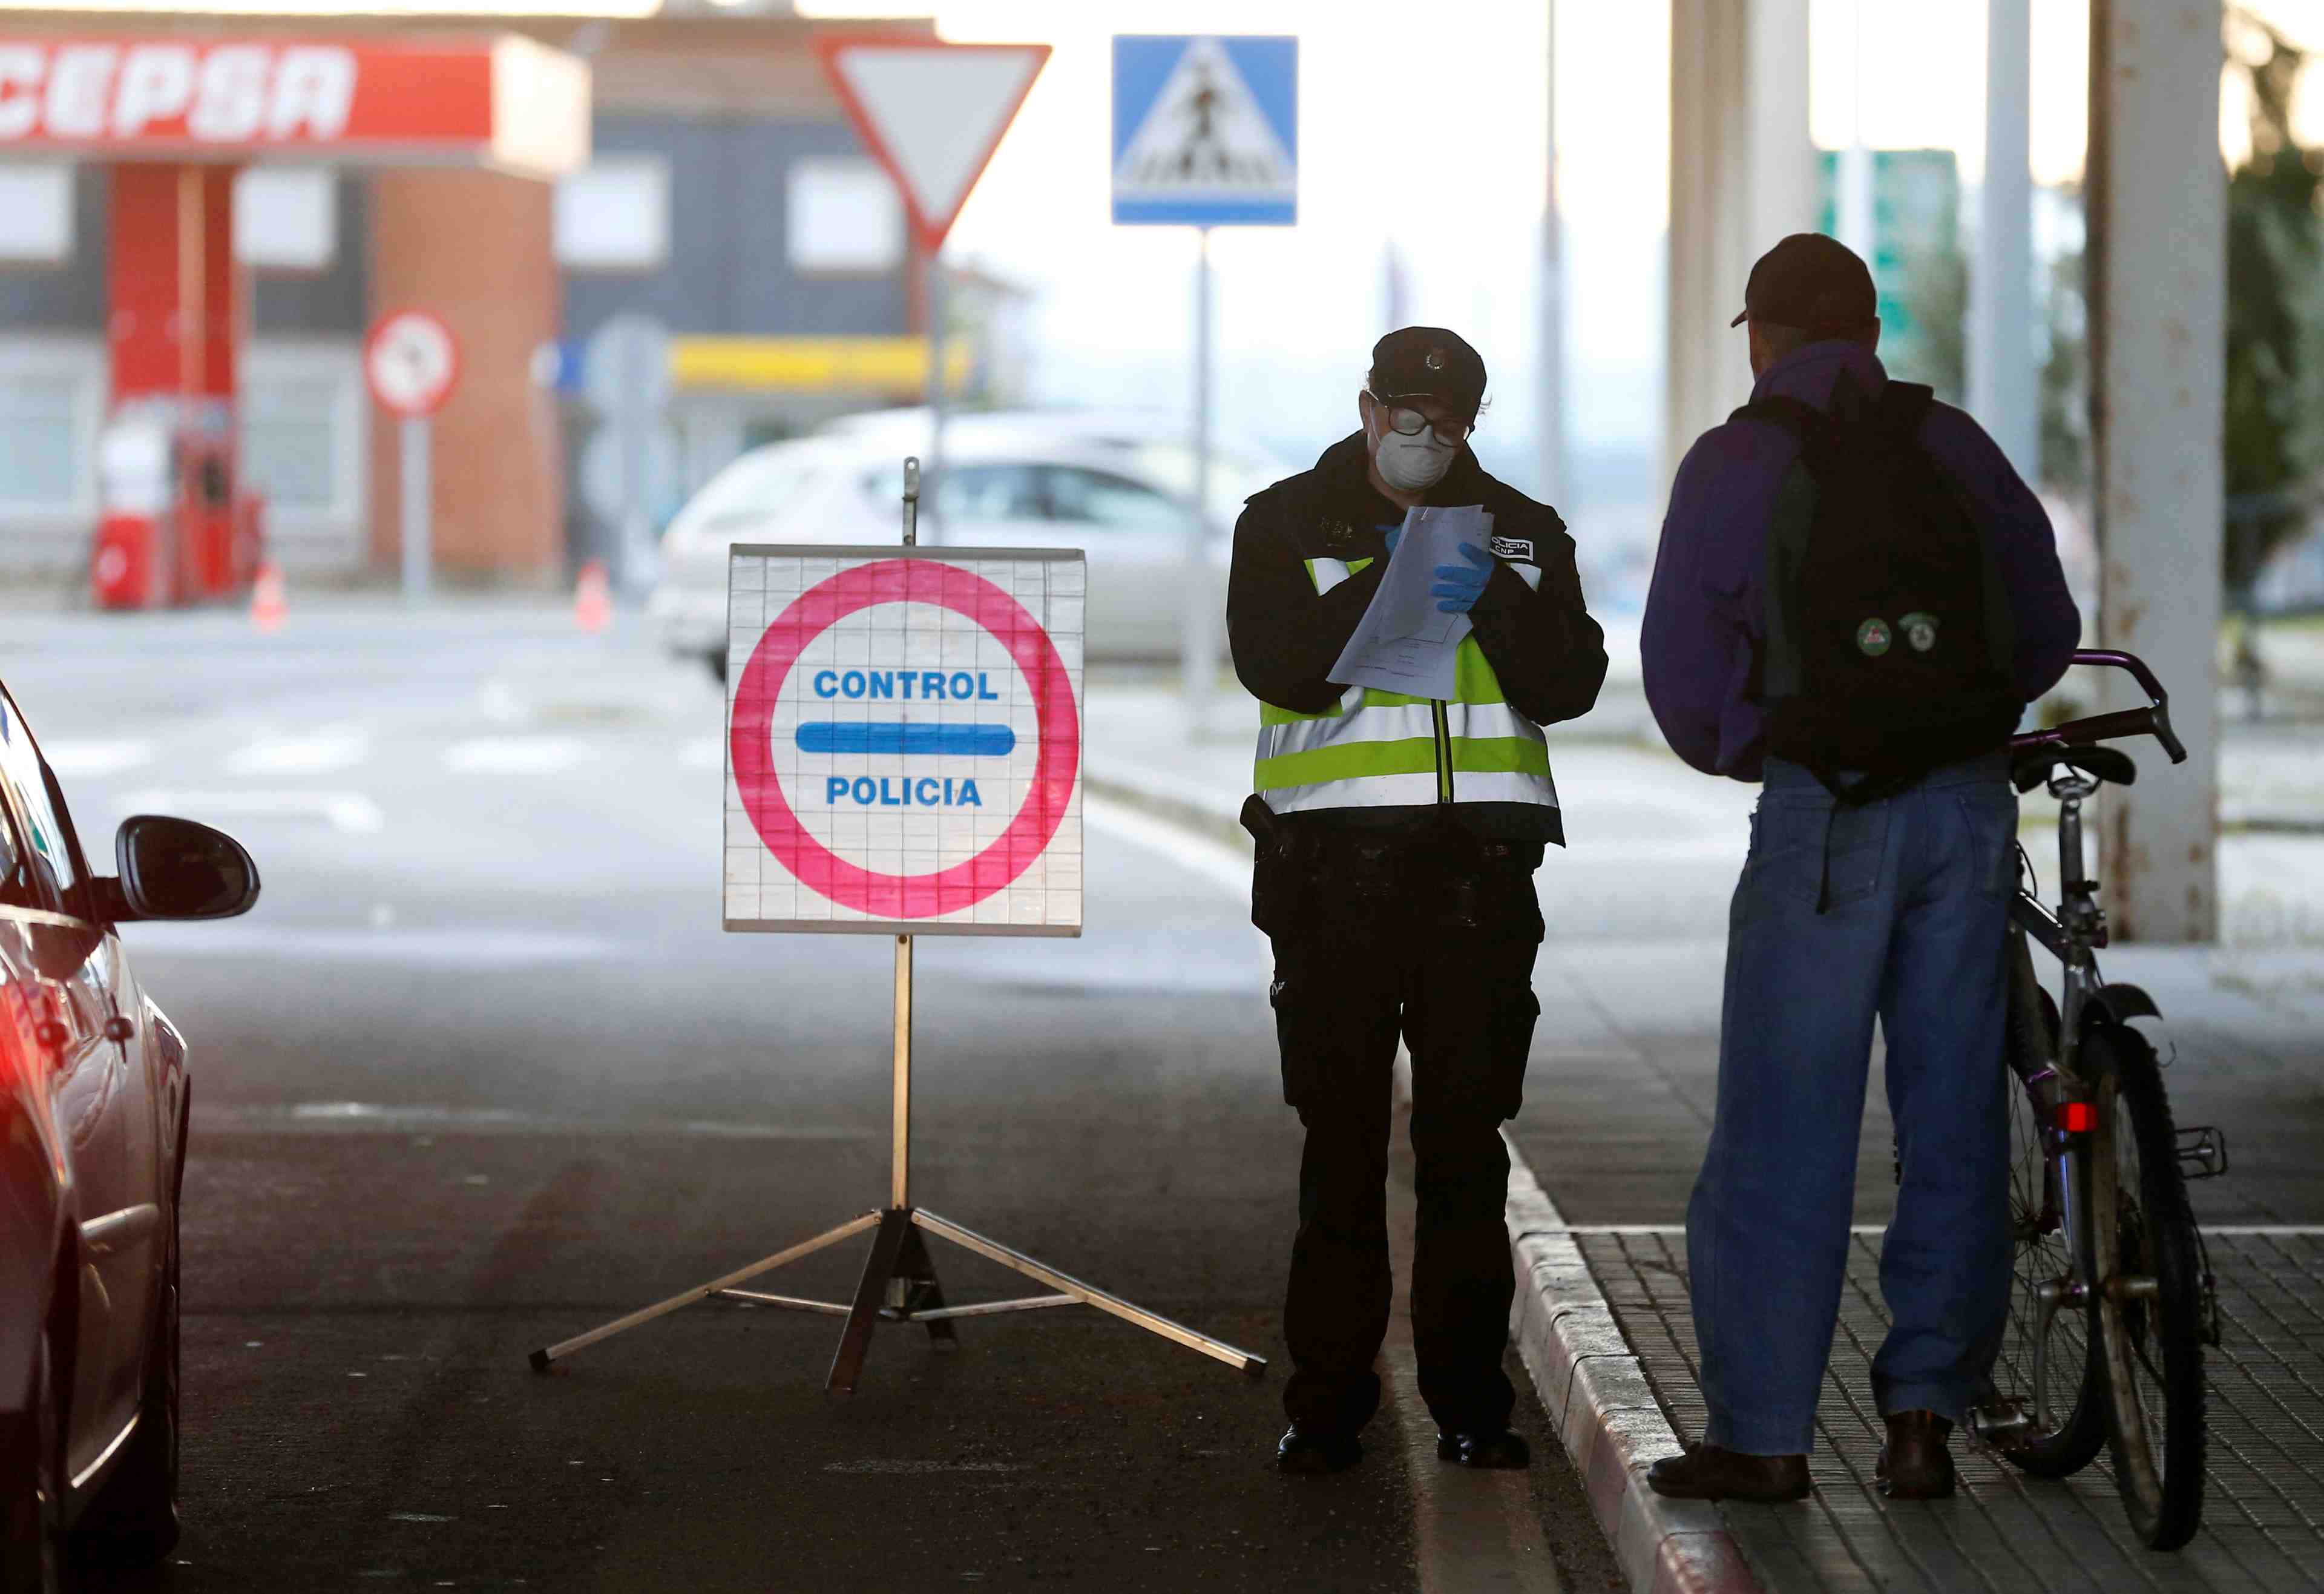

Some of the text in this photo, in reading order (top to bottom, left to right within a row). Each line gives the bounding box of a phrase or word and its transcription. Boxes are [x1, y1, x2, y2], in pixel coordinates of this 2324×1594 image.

[0, 44, 356, 143] CEPSA
[1491, 537, 1528, 549] OLICIA
[1495, 545, 1514, 555] CNP
[814, 670, 999, 700] CONTROL
[827, 777, 982, 806] POLICIA
